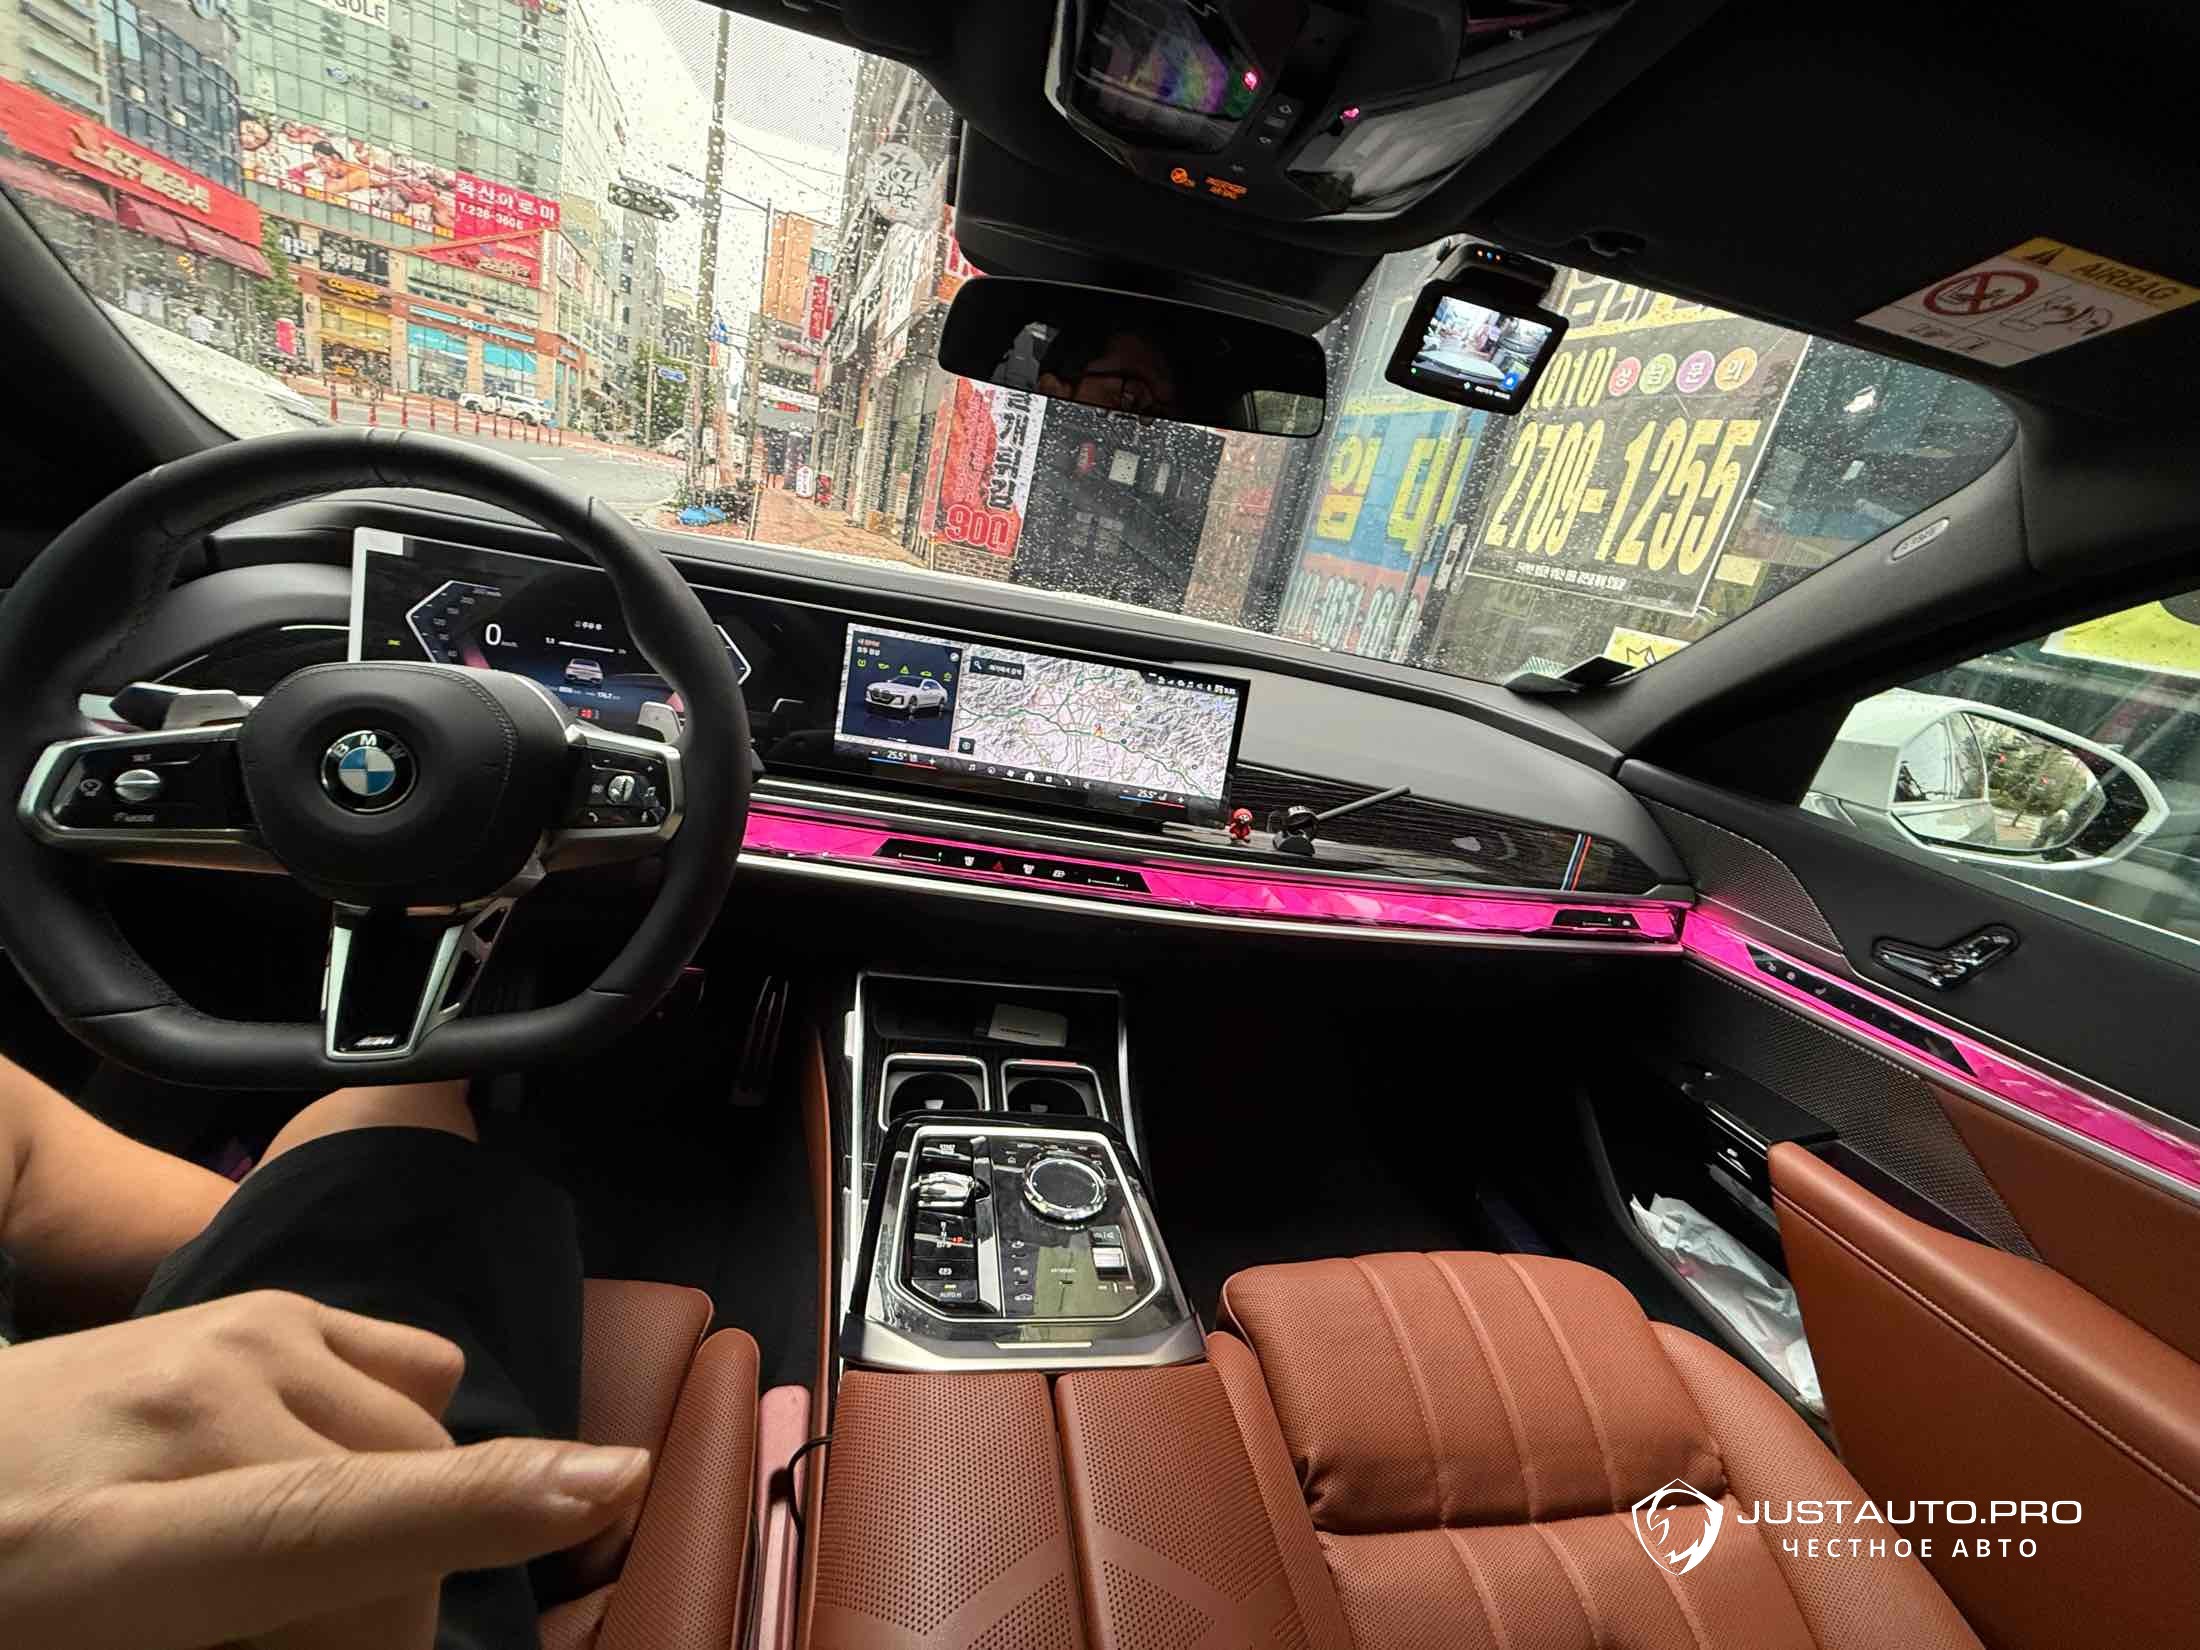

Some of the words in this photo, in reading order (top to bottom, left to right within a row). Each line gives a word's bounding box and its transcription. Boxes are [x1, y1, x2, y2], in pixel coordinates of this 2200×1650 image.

[2071, 262, 2181, 302] AIRBAG
[1484, 418, 1762, 576] 2709-1255
[943, 503, 1012, 552] 900
[485, 623, 502, 646] 0
[333, 734, 408, 760] BMW
